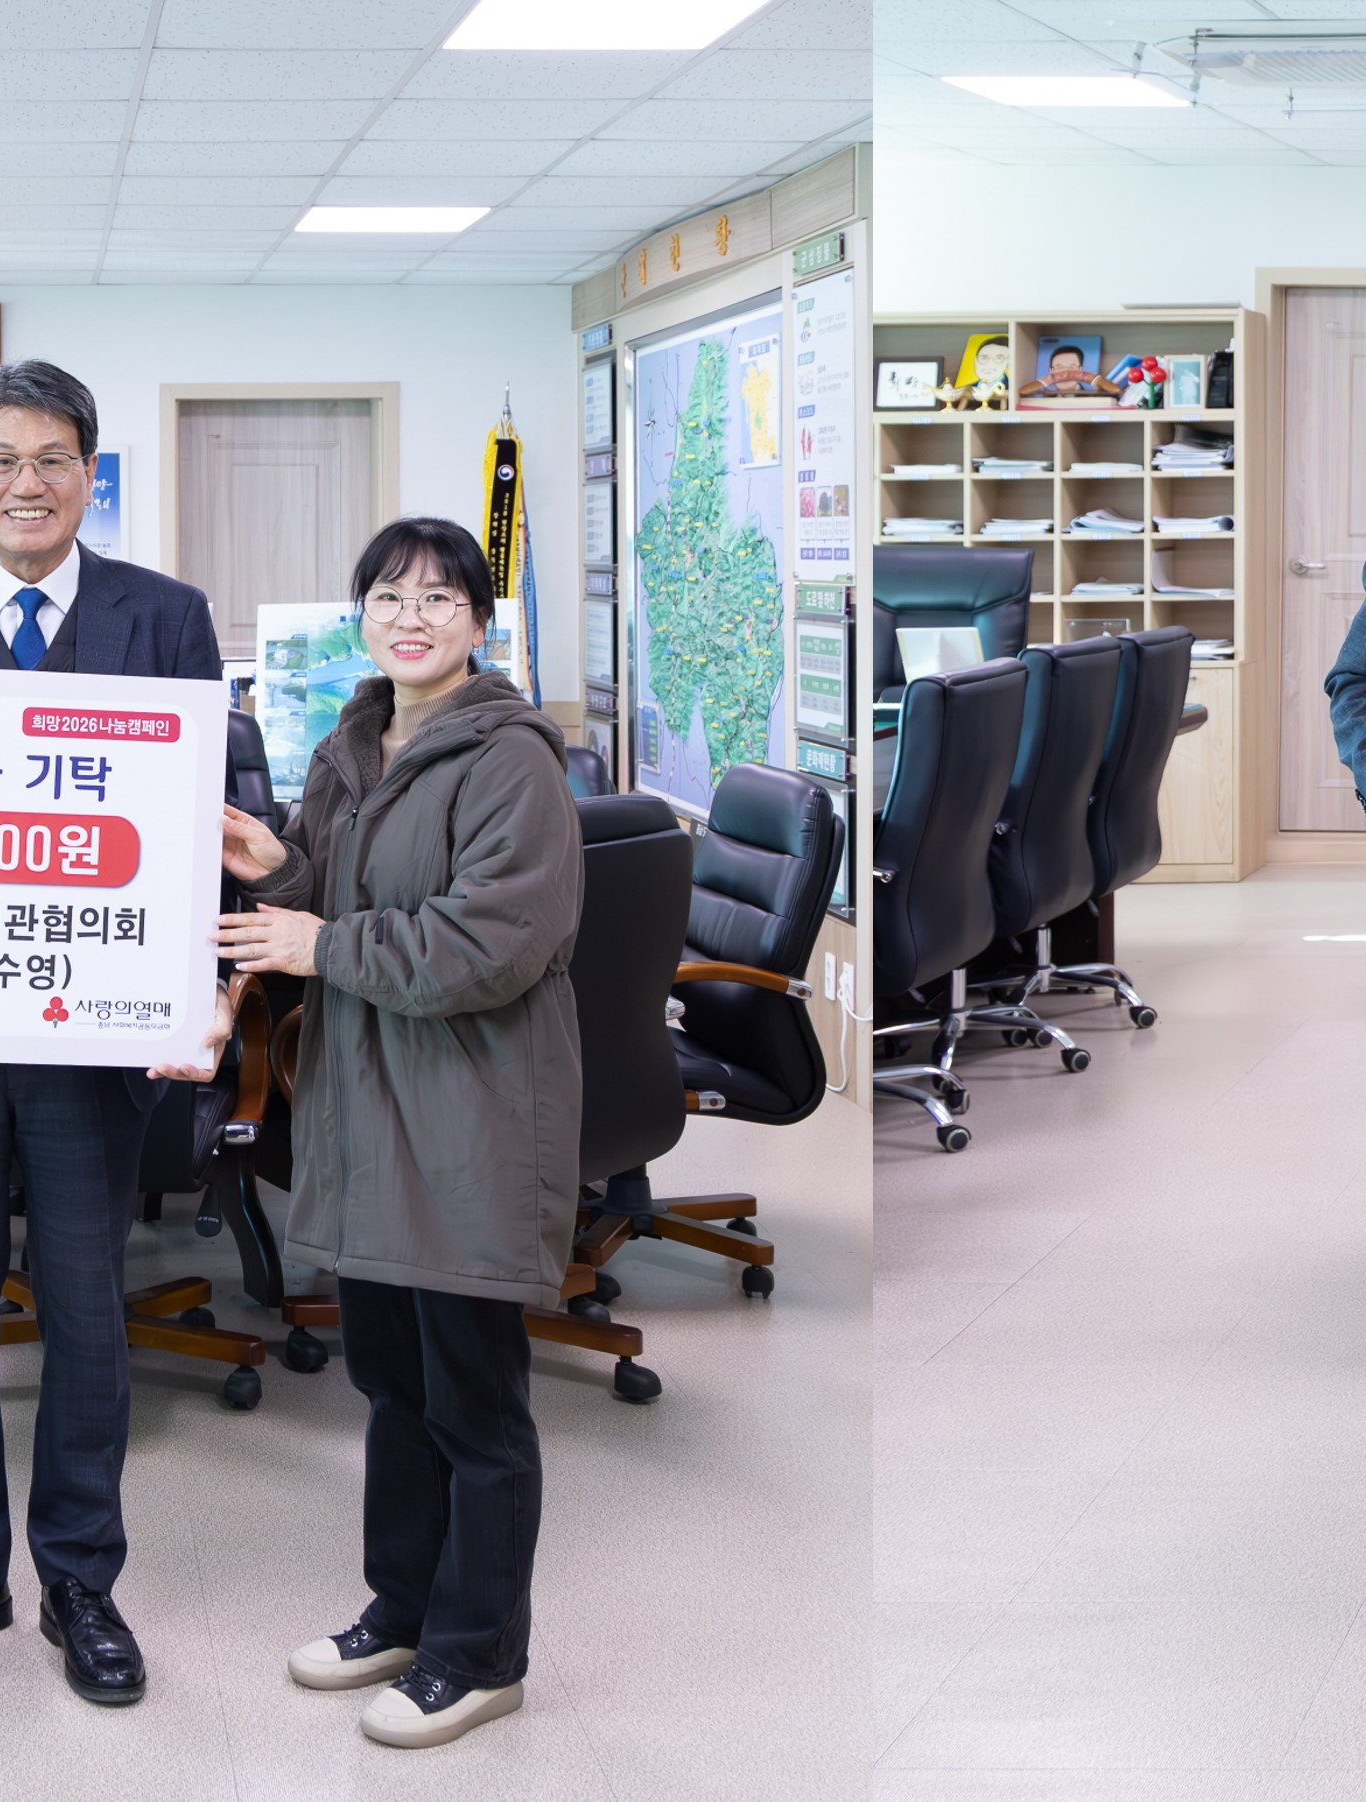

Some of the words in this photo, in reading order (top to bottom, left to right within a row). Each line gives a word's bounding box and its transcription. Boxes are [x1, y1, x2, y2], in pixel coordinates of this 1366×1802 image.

[32, 715, 170, 737] 희망2026나눔캠페인
[25, 753, 112, 802] 기탁
[75, 1000, 172, 1021] 사랑의열매
